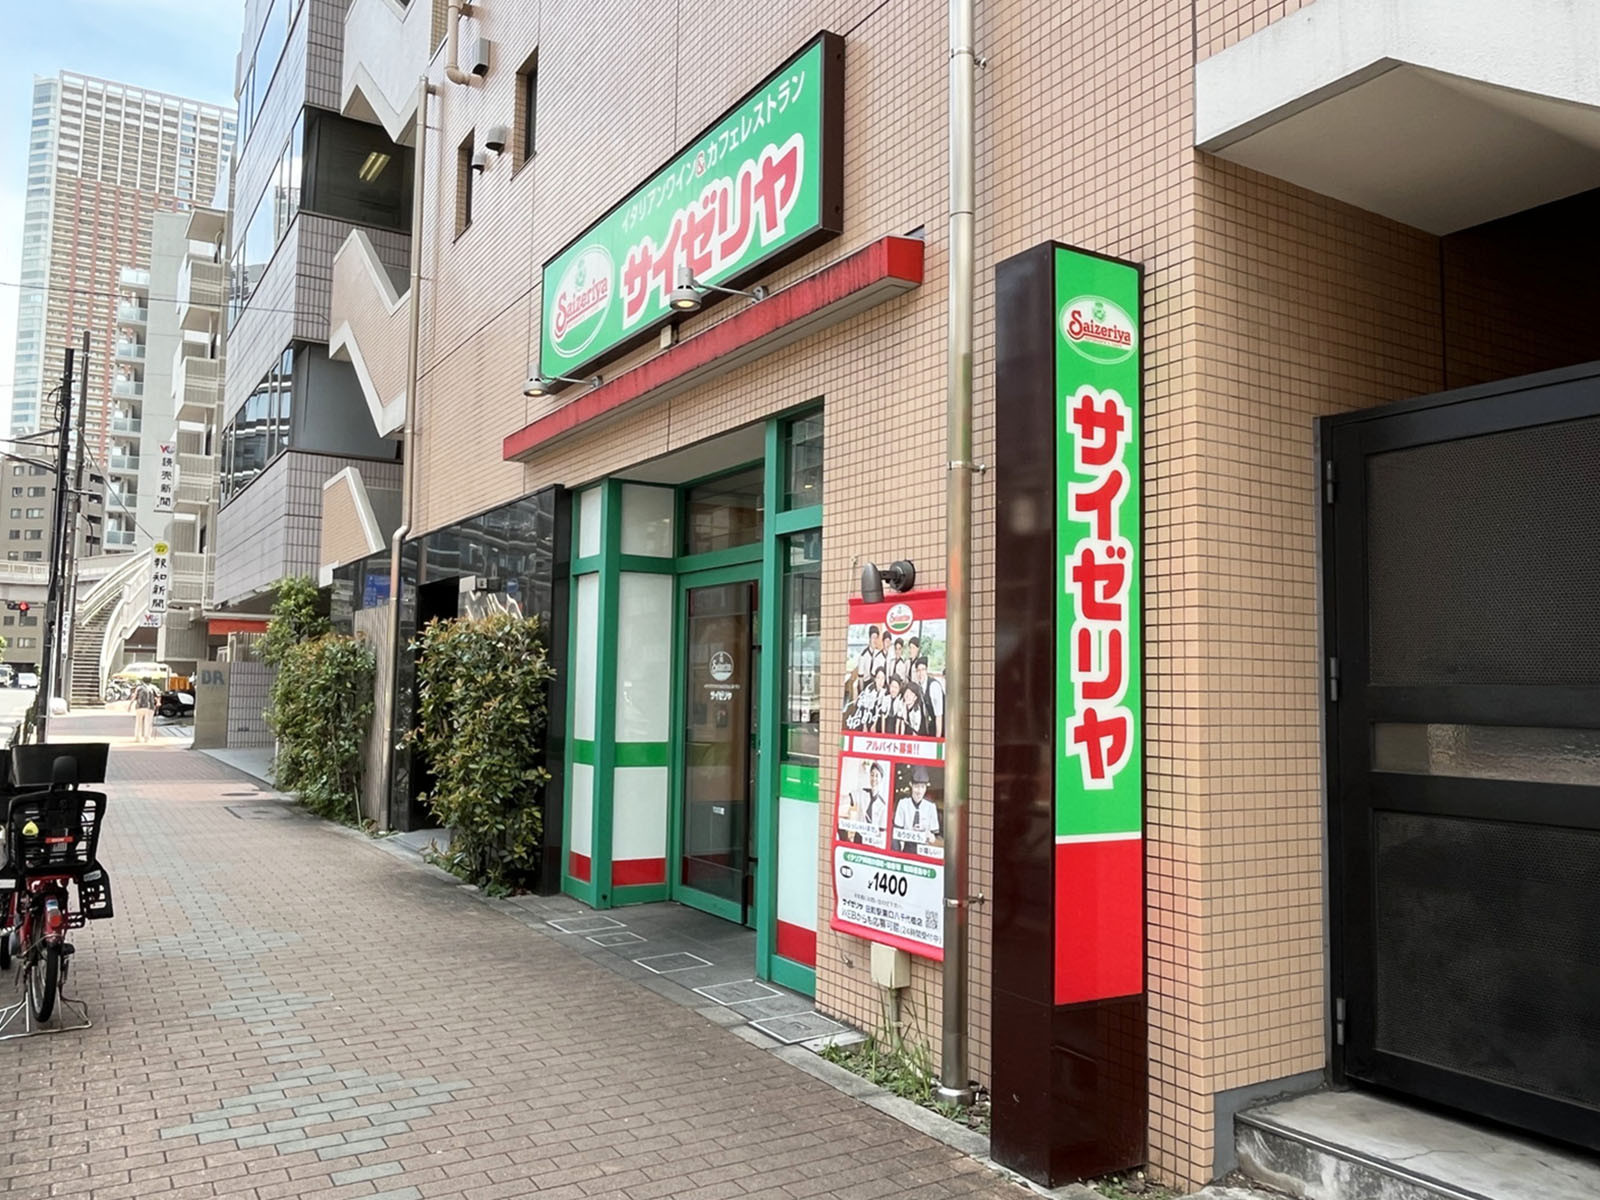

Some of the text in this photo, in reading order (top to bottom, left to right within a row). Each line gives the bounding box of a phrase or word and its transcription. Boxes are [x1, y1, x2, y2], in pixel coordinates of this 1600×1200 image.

[622, 70, 805, 233] イタリアンワイン&カフェレストラン
[621, 138, 802, 325] サイゼリヤ
[555, 276, 608, 334] Saizeriya
[1068, 309, 1132, 344] Saizeriya
[152, 558, 167, 609] 報知新聞
[1069, 391, 1130, 784] サイゼリヤ
